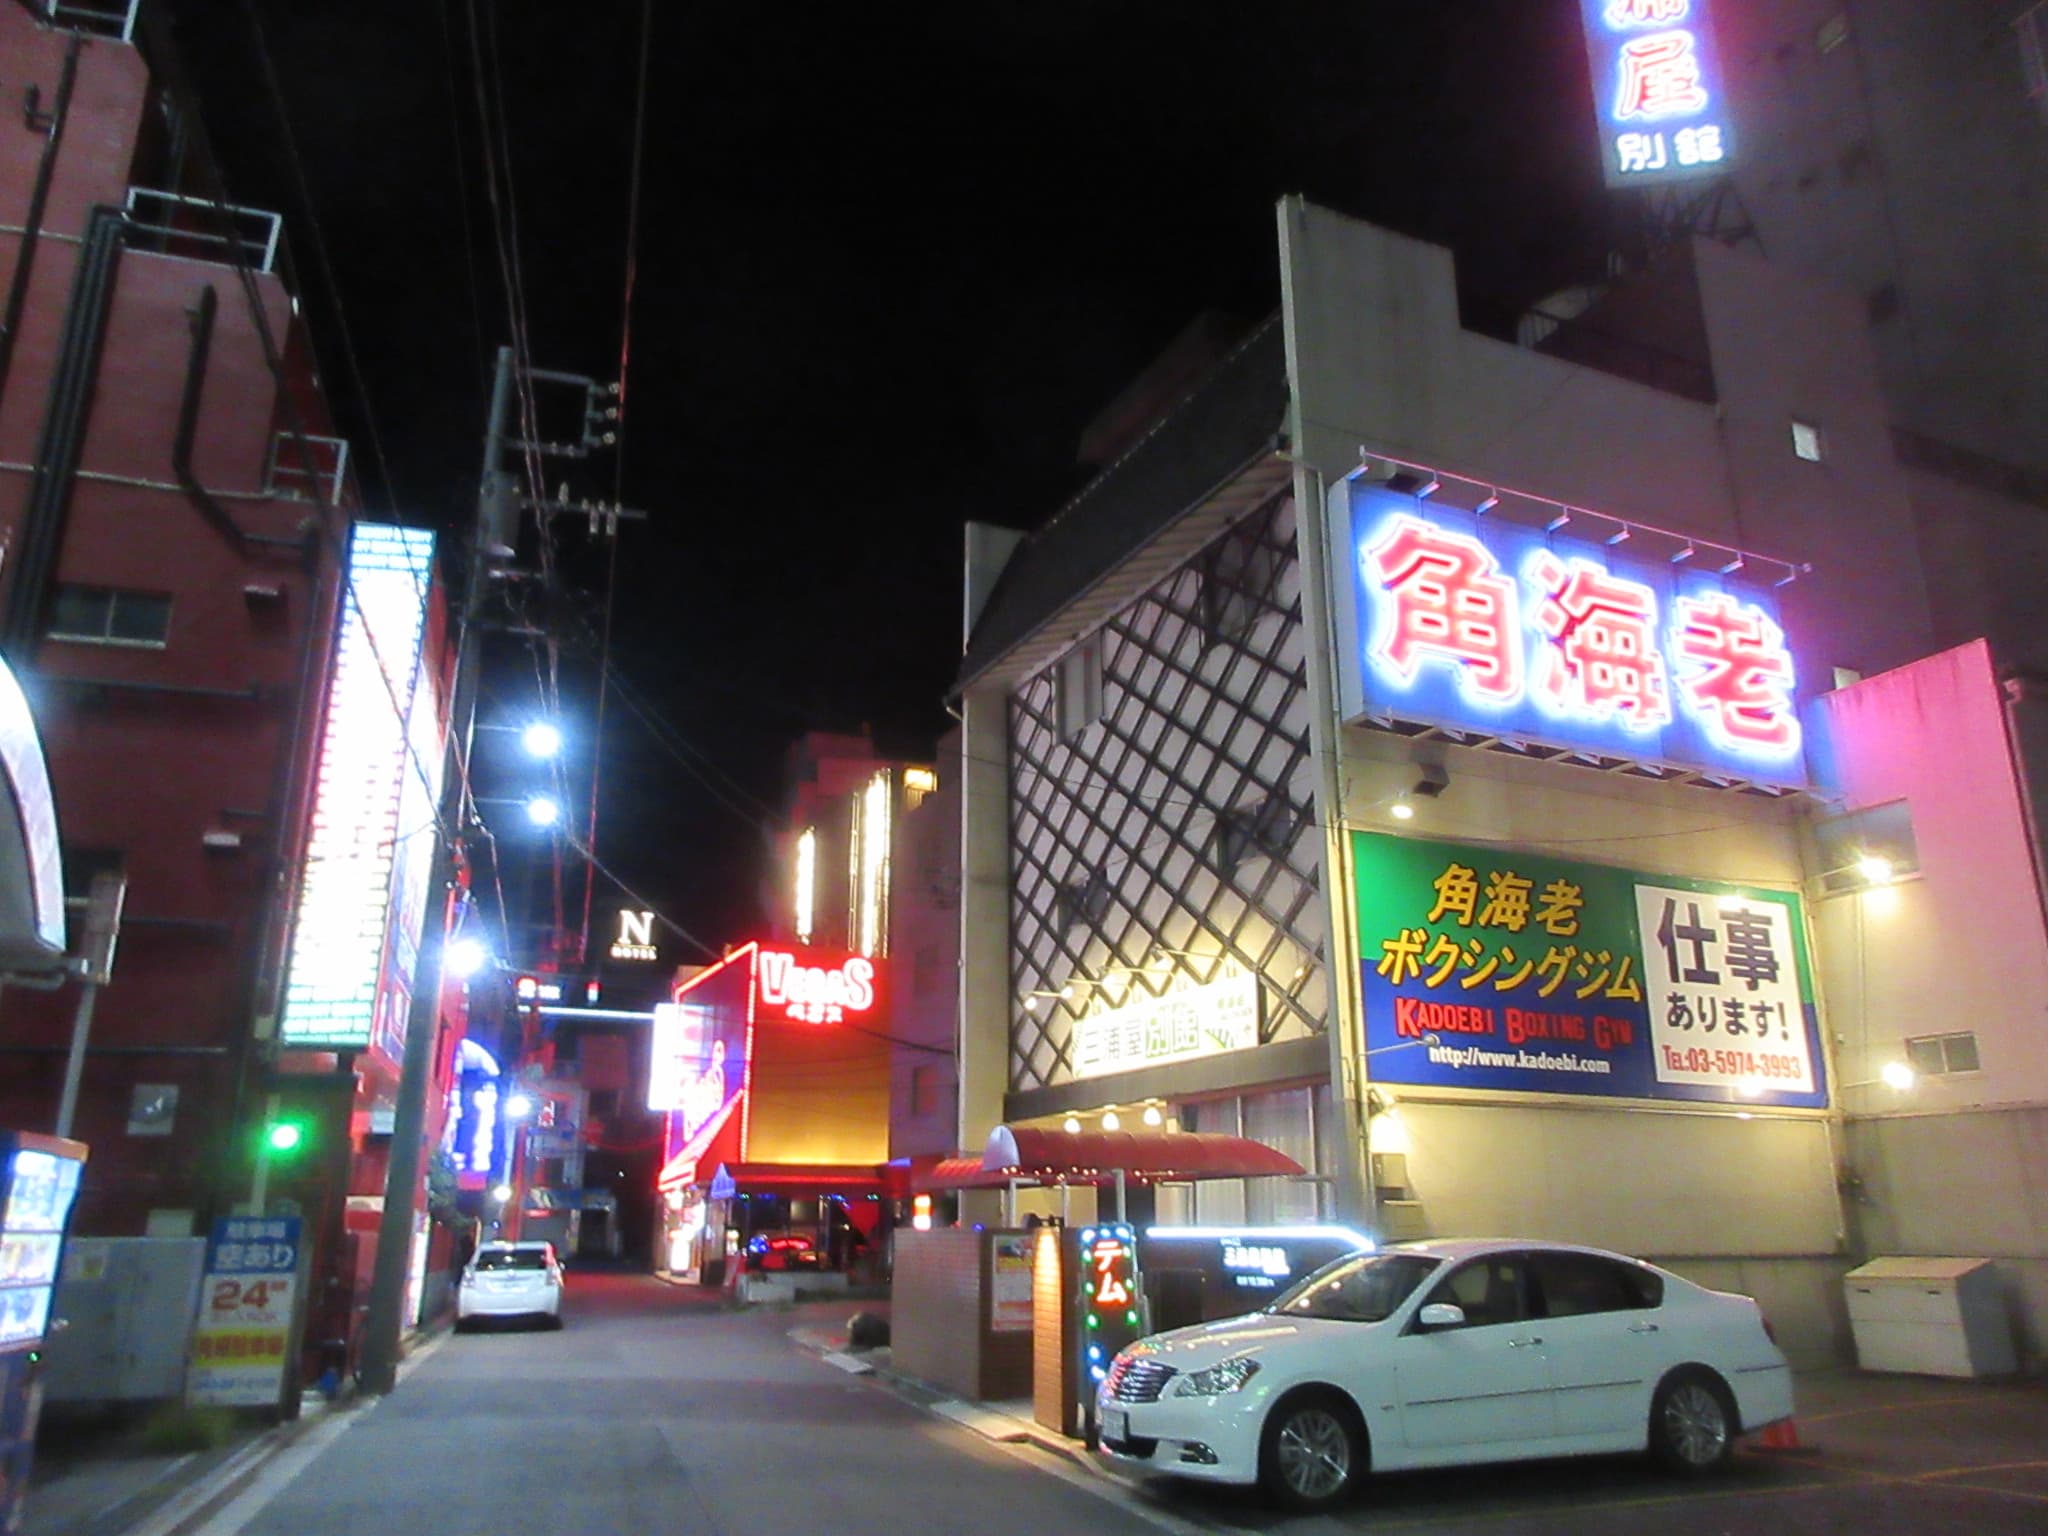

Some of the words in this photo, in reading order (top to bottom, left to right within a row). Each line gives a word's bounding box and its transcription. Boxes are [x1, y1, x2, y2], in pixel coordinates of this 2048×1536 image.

[1362, 512, 1802, 757] 角海老
[617, 909, 655, 946] N
[1426, 862, 1584, 937] 角海老
[1375, 926, 1642, 1003] ボクシングジム
[1658, 897, 1781, 991] 仕事
[1395, 997, 1494, 1038] KADOEBI
[1505, 1006, 1586, 1044] BOXING
[1429, 1046, 1611, 1074] http://www.kadoebi.com
[1094, 1241, 1127, 1303] テム
